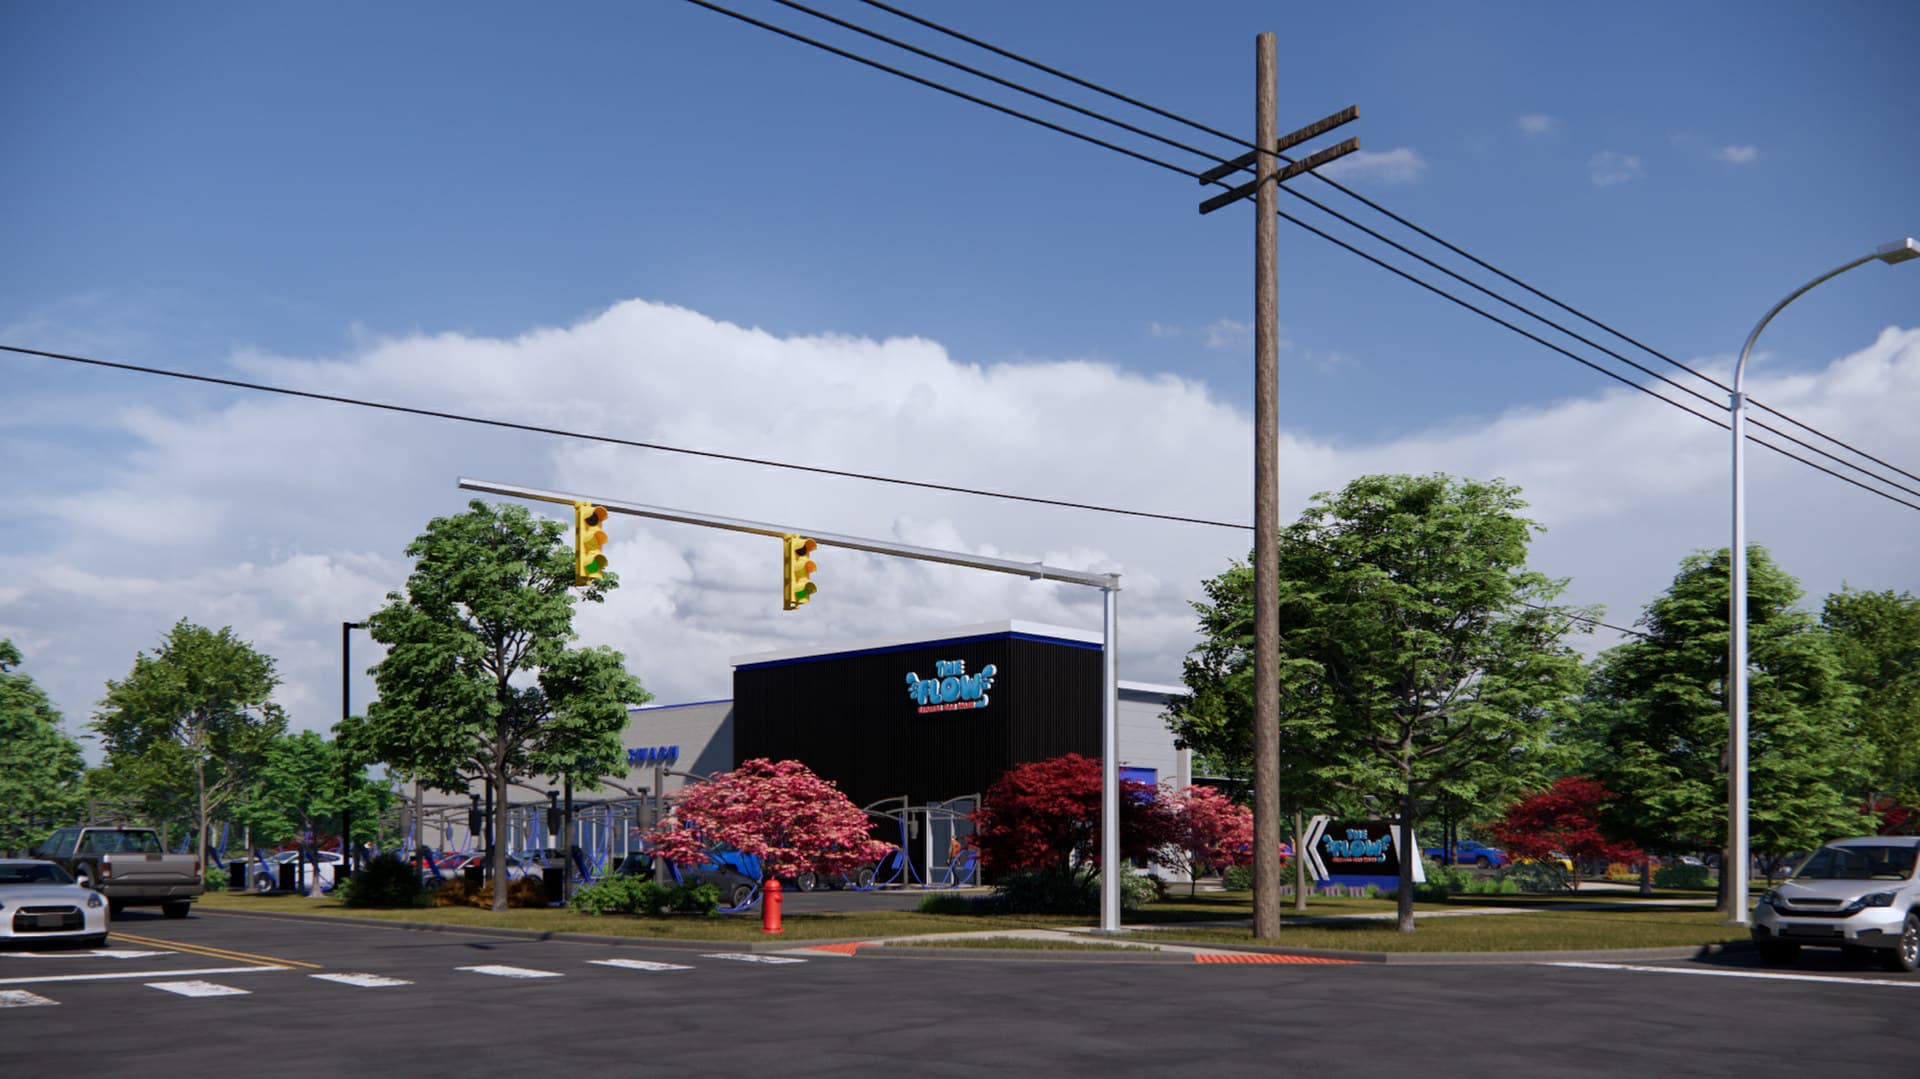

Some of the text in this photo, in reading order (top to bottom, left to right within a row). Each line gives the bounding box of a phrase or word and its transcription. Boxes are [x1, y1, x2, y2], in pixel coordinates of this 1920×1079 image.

[936, 660, 965, 678] THE
[918, 673, 982, 705] FLOW
[1345, 828, 1368, 840] THE
[1332, 840, 1382, 857] FLOW
